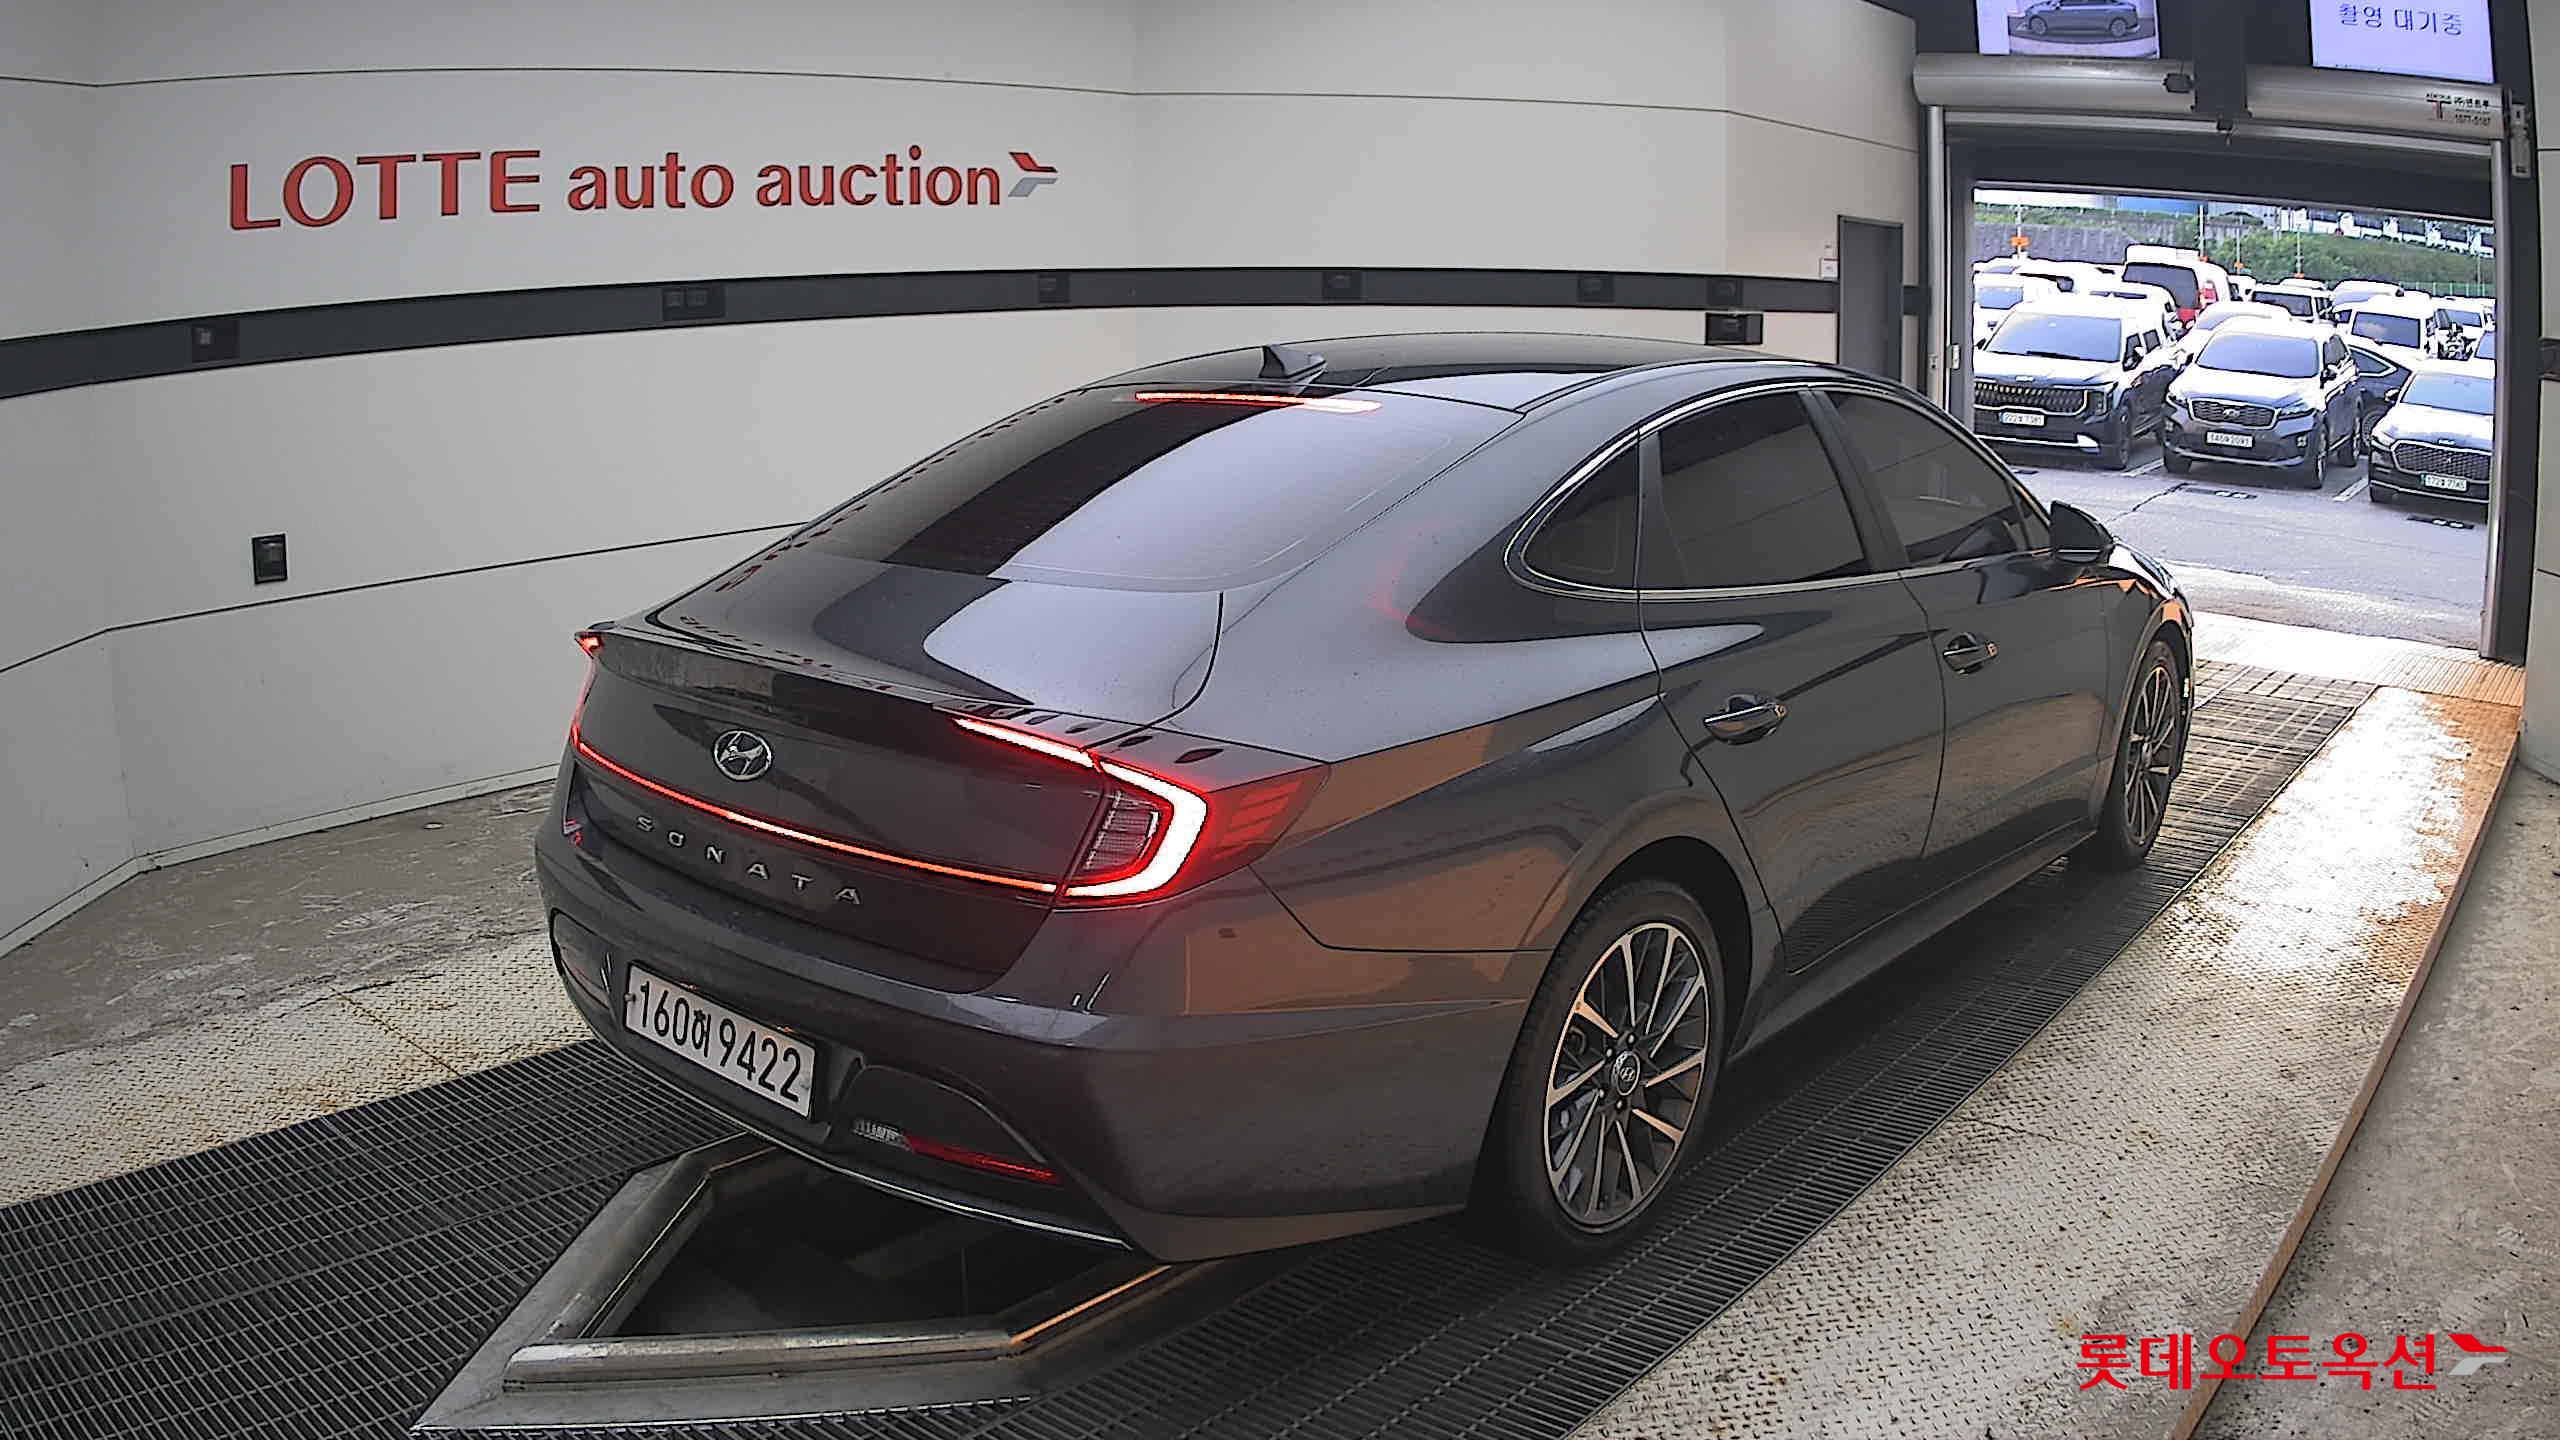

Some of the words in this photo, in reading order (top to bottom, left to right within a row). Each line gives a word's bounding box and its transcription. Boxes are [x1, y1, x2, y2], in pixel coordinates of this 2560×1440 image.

[2339, 3, 2383, 29] 촬영
[2394, 9, 2462, 36] 대기중
[230, 150, 541, 231] LOTTE
[567, 152, 735, 210] auto
[756, 145, 1002, 207] auction
[636, 816, 861, 905] SONATA
[640, 980, 801, 1103] 160허9422
